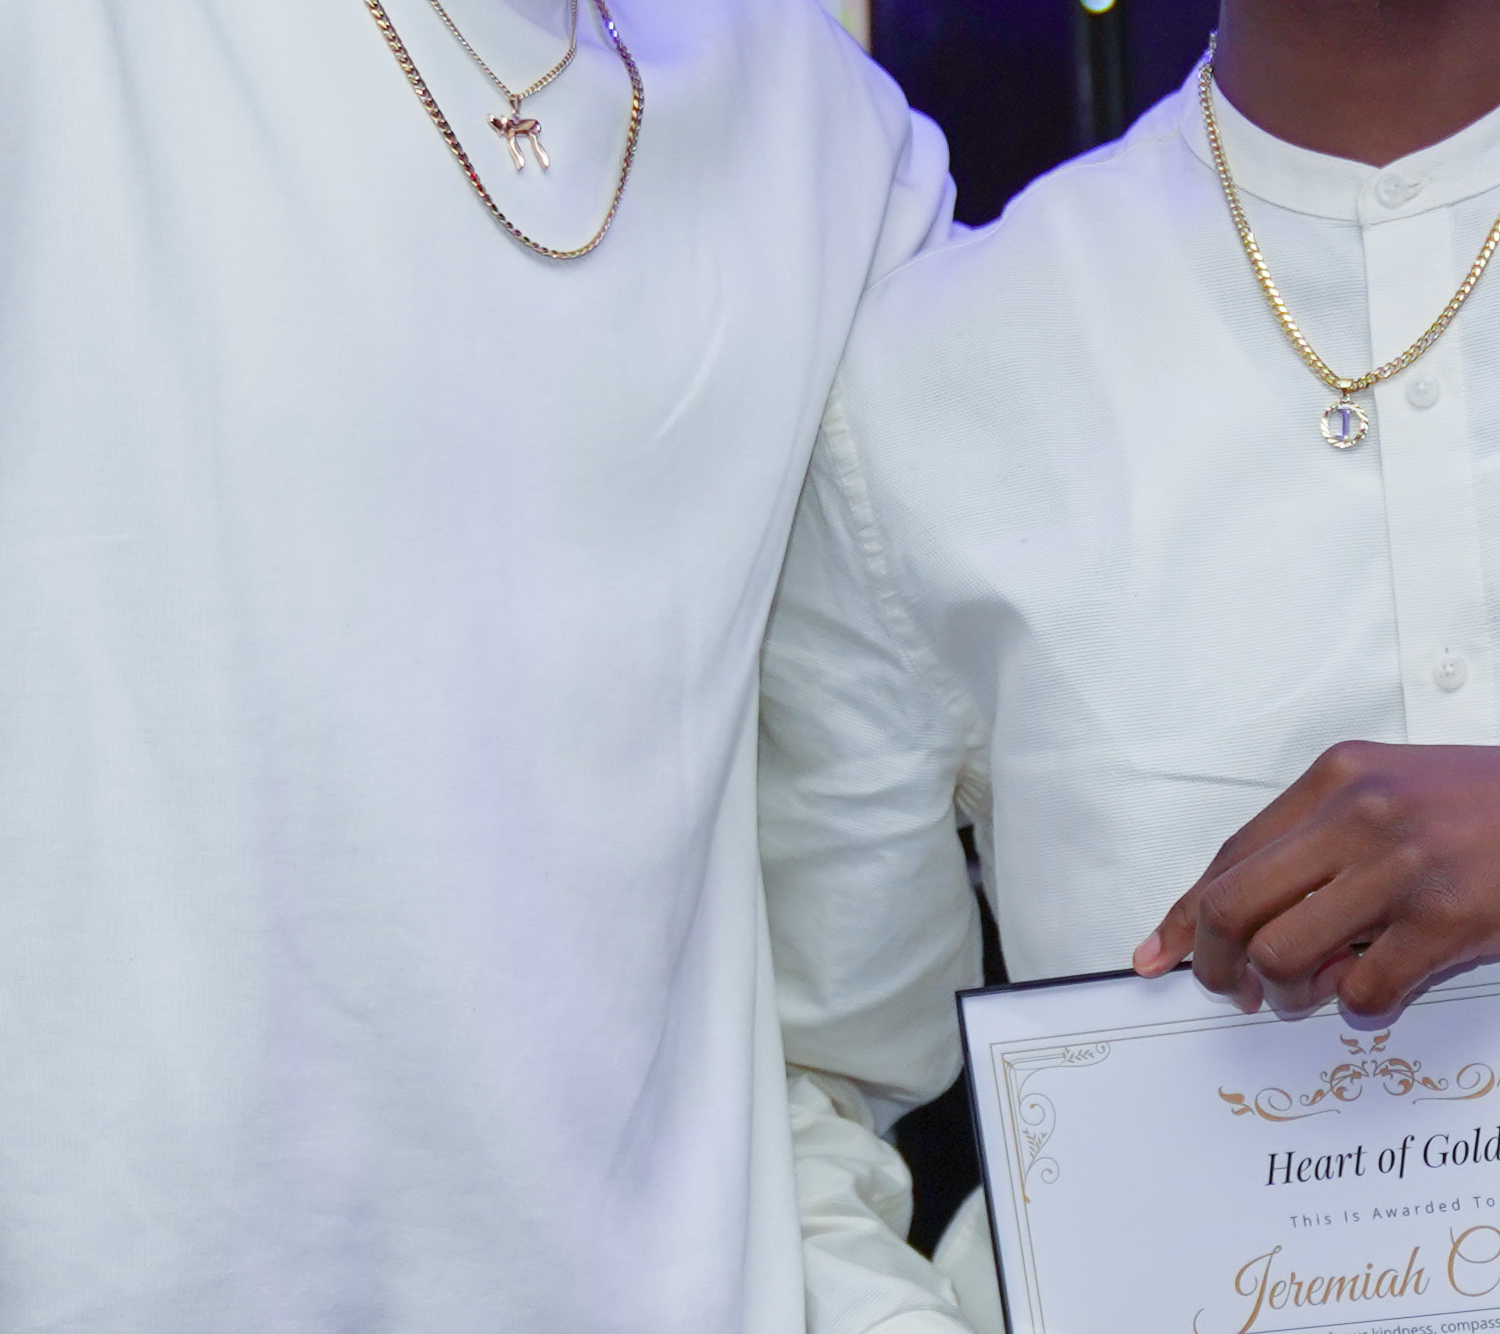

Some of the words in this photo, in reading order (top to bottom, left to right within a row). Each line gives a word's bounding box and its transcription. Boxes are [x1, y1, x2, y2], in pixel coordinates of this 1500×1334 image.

[1264, 1144, 1368, 1187] Heart
[1378, 1134, 1416, 1180] of
[1289, 1212, 1332, 1229] This
[1344, 1210, 1360, 1224] Is
[1372, 1198, 1461, 1220] Awarded
[1472, 1195, 1497, 1210] To
